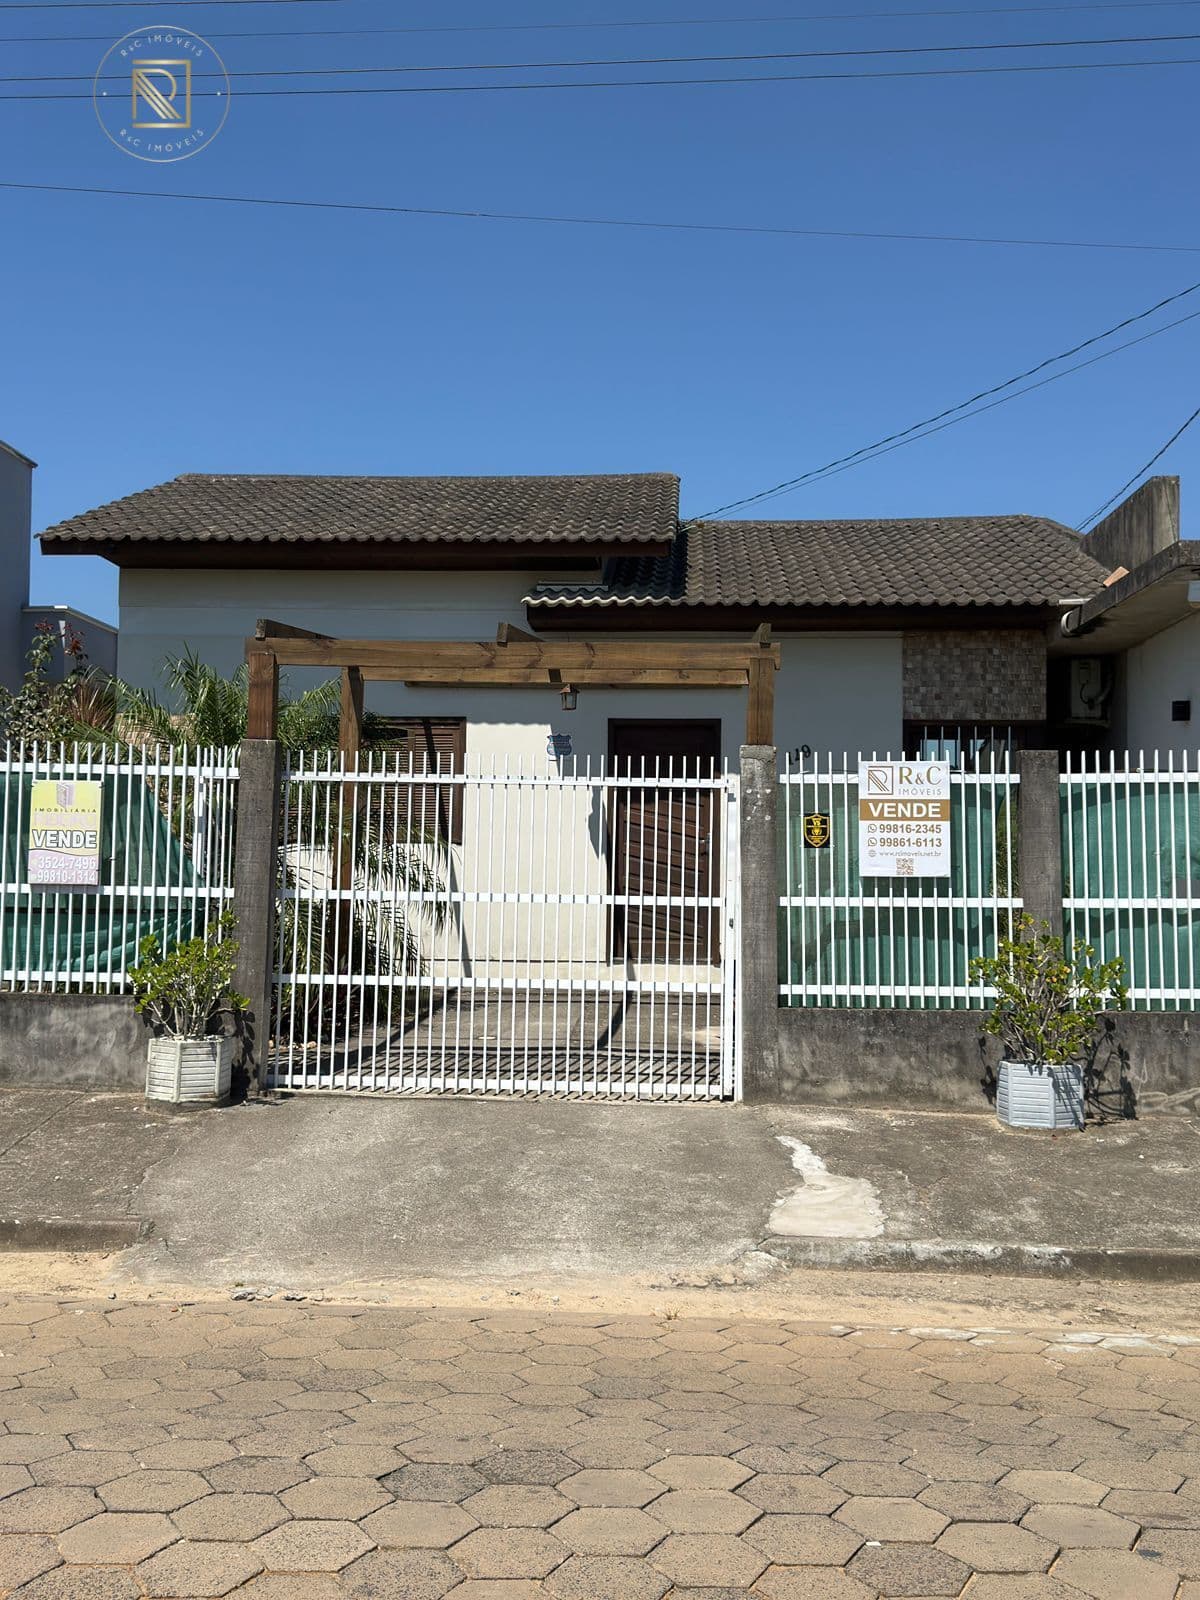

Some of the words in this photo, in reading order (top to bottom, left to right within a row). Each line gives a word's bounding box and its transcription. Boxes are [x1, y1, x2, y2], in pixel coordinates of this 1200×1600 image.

[899, 766, 941, 785] R&C
[868, 803, 942, 818] VENDE
[879, 823, 942, 834] 99816-2345
[32, 829, 98, 848] VENDE
[879, 837, 942, 848] 99861-6113
[38, 856, 96, 870] 3524-7496
